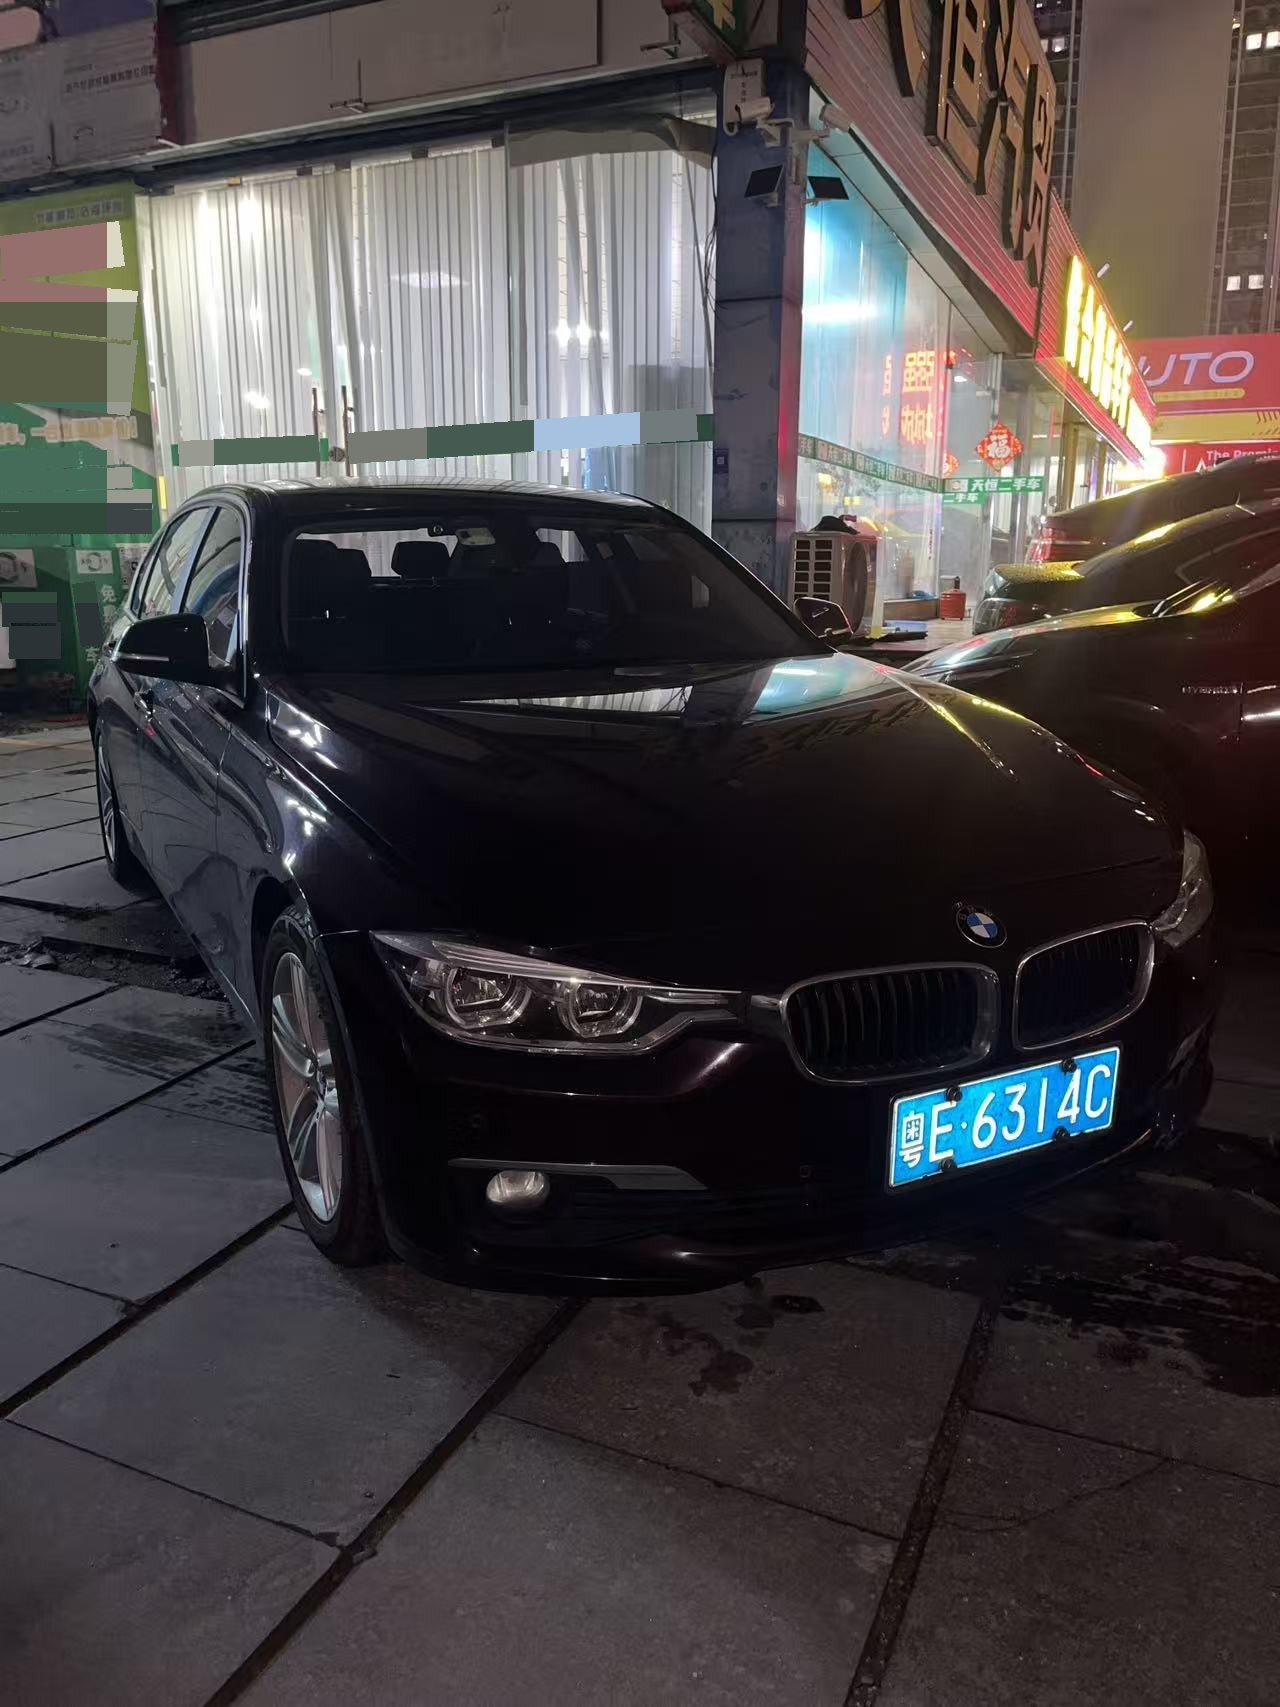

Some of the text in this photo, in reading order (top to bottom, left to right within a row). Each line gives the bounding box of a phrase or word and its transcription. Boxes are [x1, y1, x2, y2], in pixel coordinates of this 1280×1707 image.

[987, 434, 1011, 458] 福
[970, 477, 1041, 492] 天恒二手车
